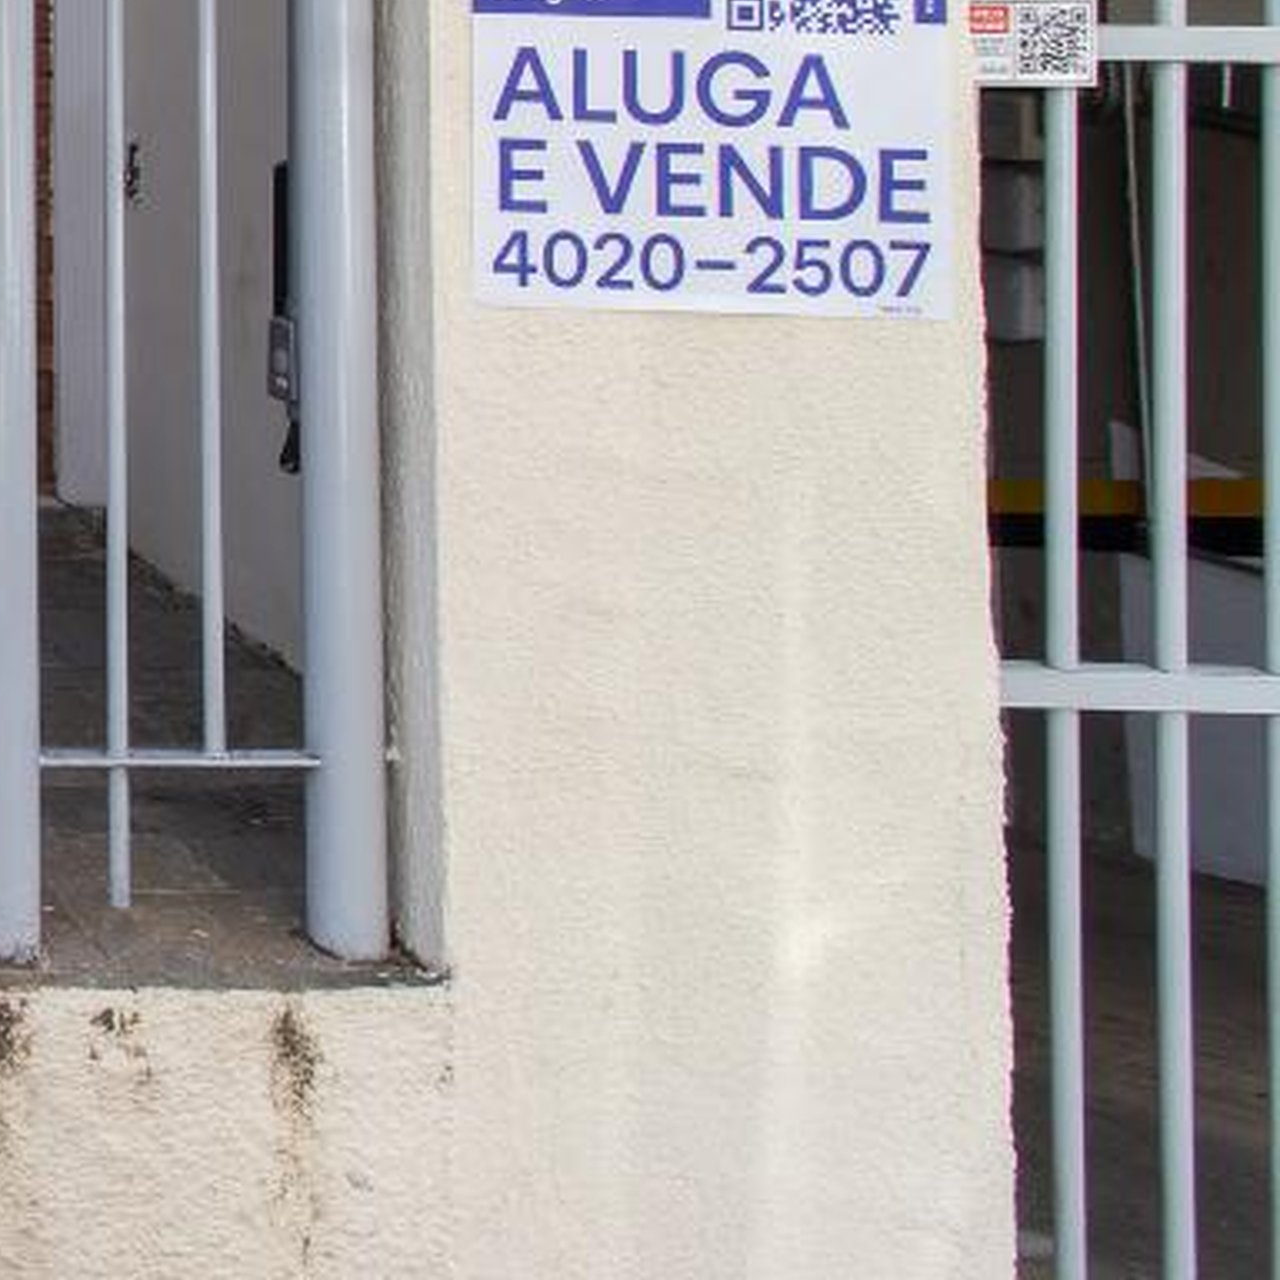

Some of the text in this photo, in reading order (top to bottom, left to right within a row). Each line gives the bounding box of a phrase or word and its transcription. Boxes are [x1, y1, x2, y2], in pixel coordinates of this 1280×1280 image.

[491, 45, 851, 130] ALUGA
[497, 137, 931, 224] E VENDE
[491, 229, 932, 298] 4020-2507
